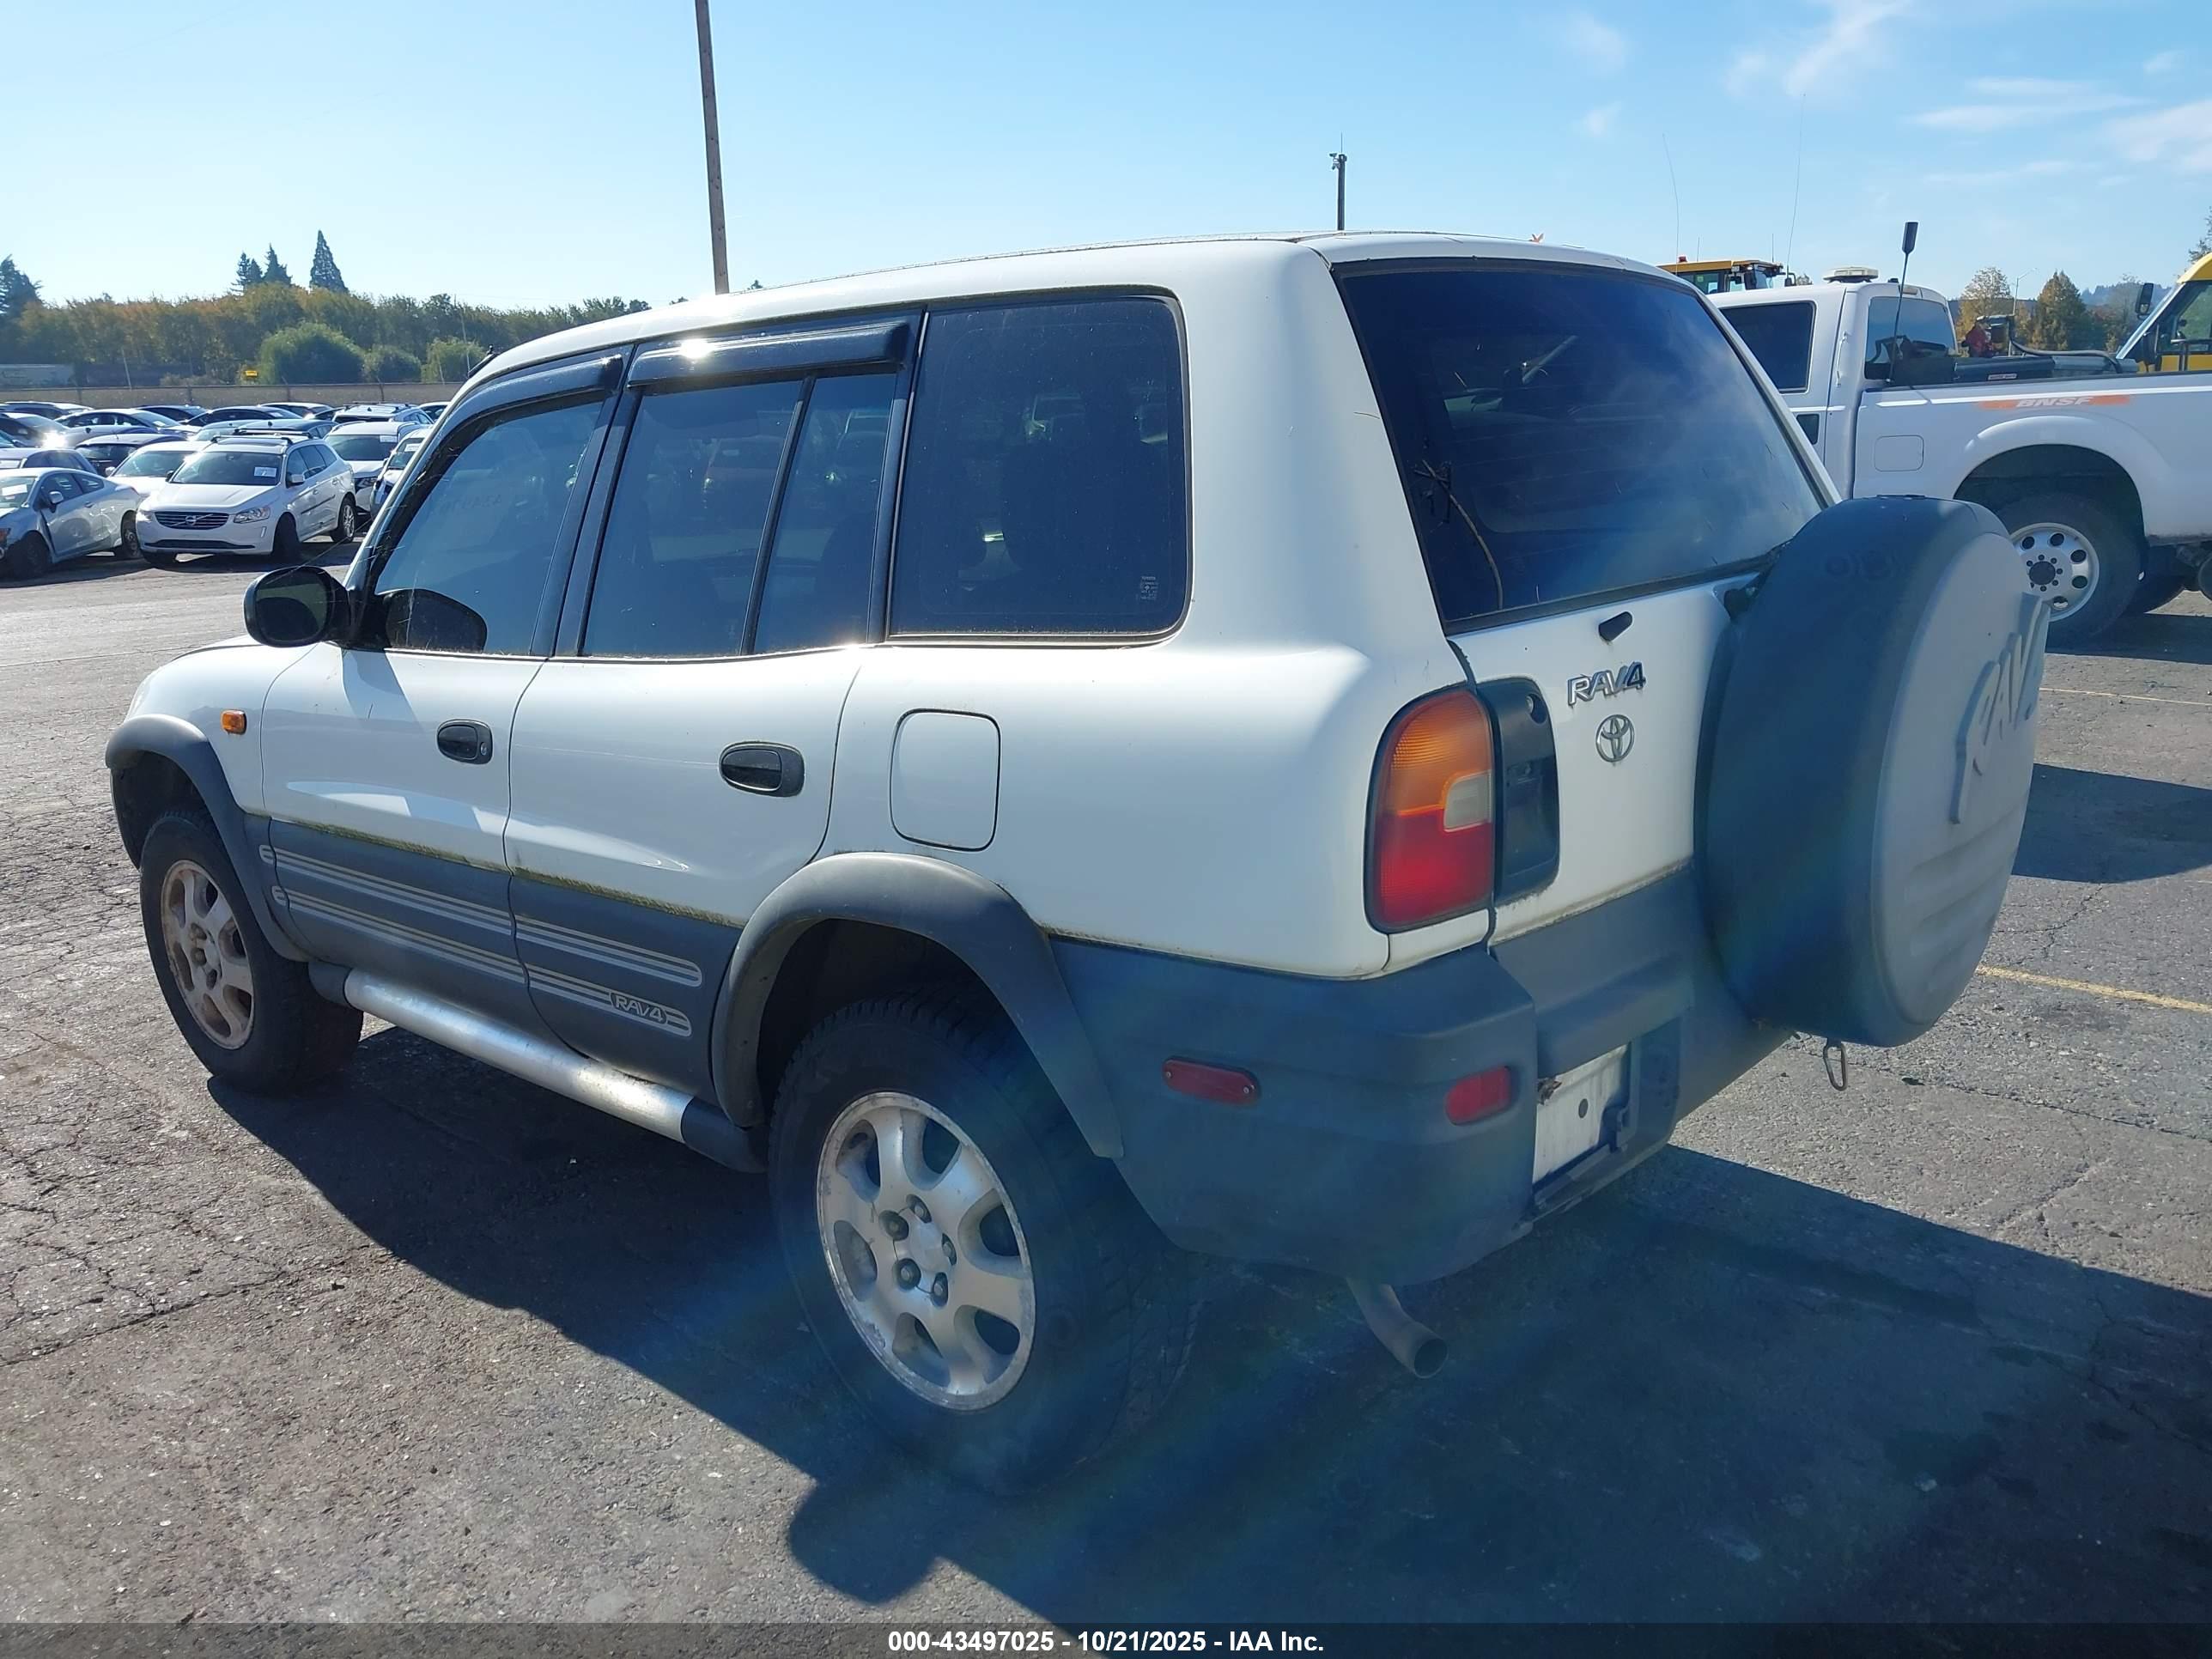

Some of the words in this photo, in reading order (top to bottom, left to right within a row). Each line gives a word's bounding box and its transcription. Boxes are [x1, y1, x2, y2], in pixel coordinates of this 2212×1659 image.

[2016, 397, 2094, 408] BNSF
[1567, 661, 1646, 706] RAV4
[616, 995, 663, 1022] RAV4
